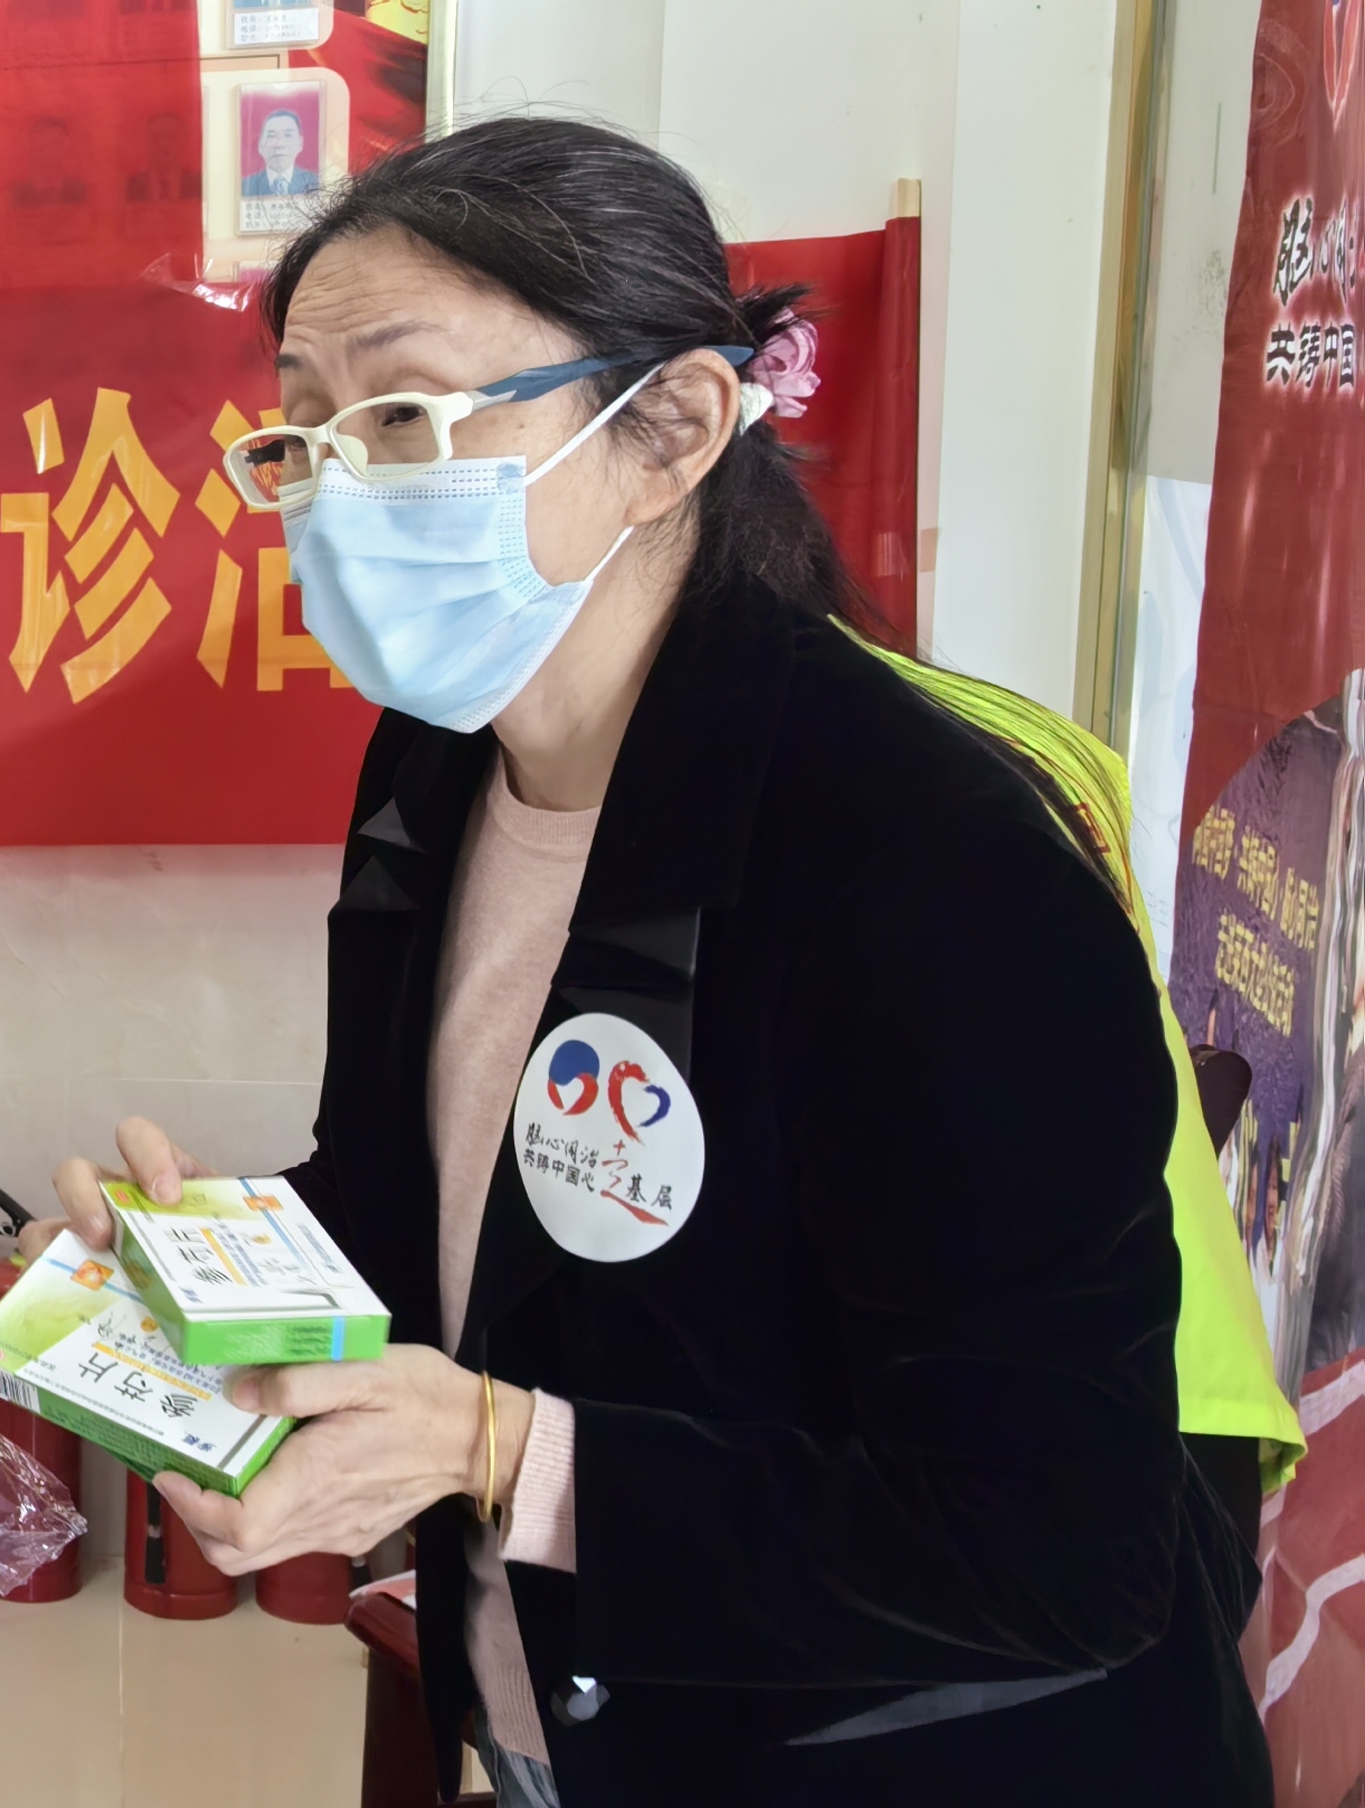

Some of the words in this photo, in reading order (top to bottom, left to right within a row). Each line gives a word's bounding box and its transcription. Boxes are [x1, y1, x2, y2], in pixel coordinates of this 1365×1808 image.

[522, 1148, 596, 1193] 共铸中国心
[76, 1352, 200, 1419] 参芍片
